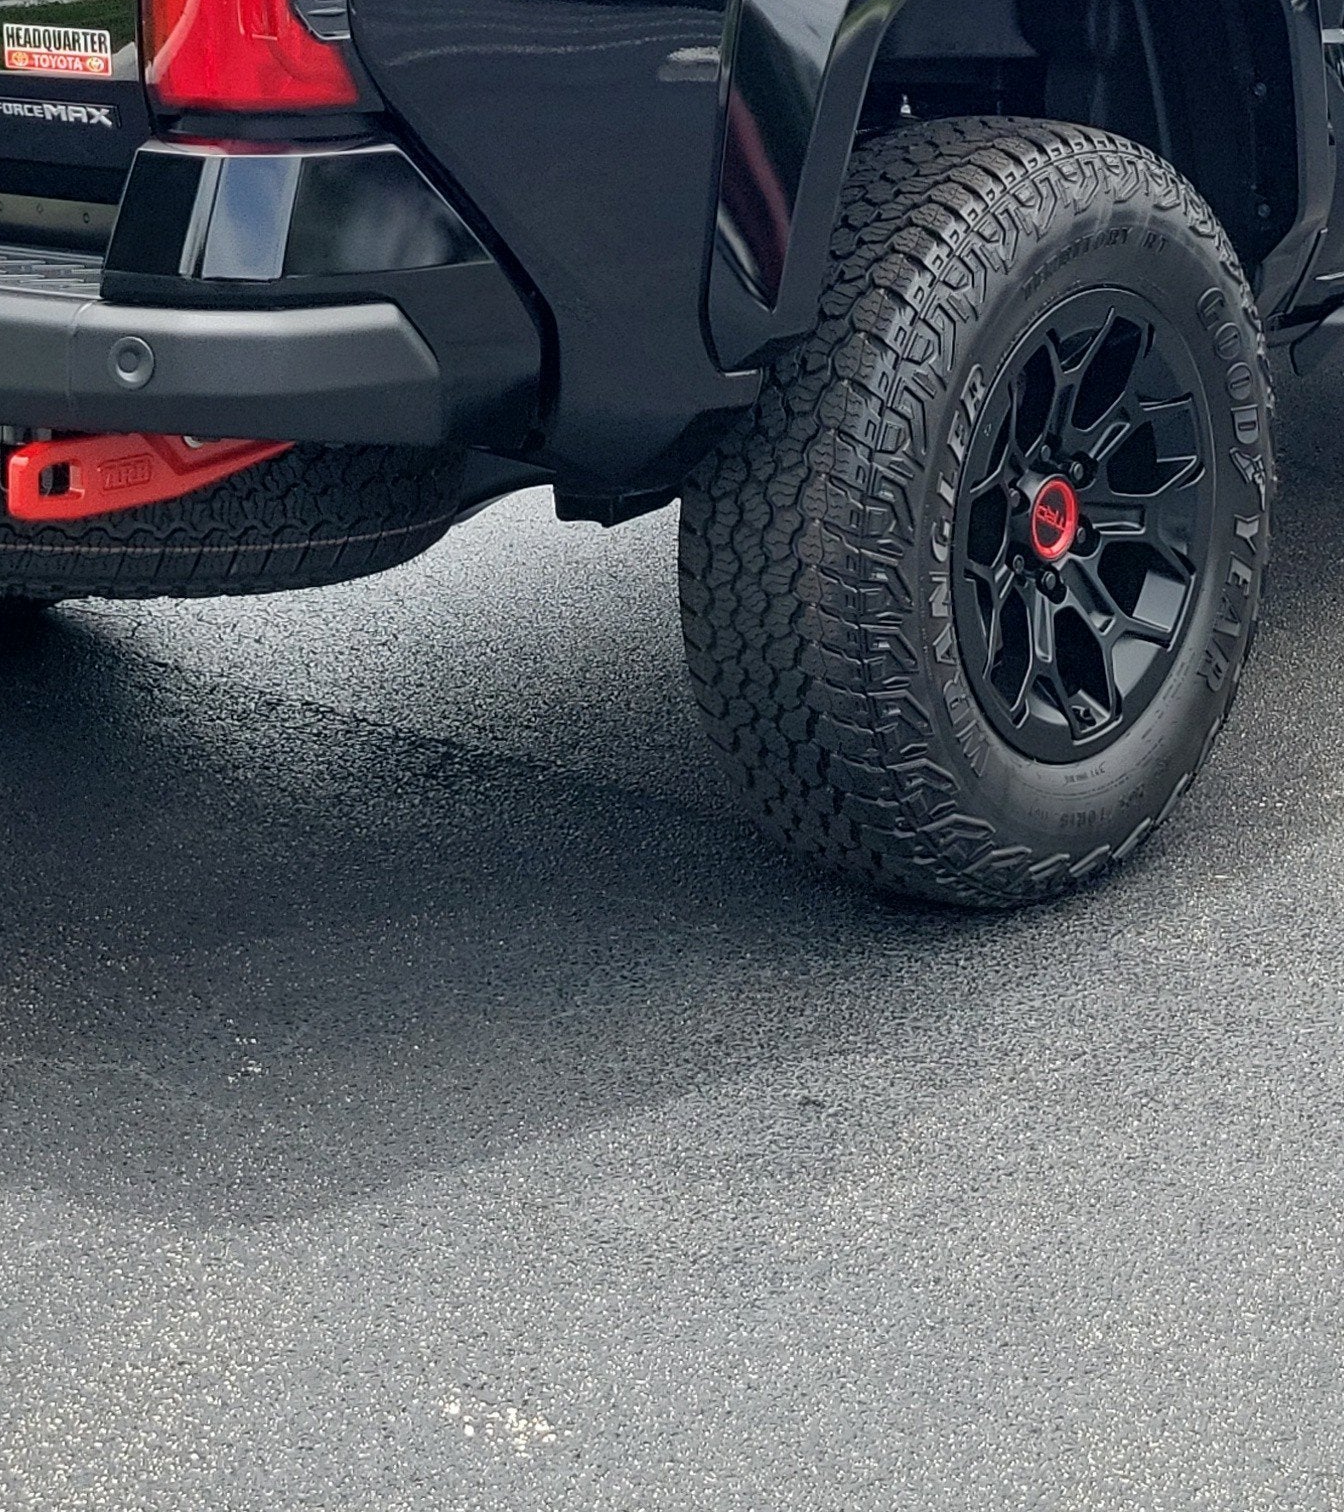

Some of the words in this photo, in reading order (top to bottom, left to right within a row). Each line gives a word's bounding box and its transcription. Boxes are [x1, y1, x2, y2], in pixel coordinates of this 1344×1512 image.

[5, 25, 108, 54] HEADQUARTER
[32, 54, 84, 71] TOYOTA
[929, 363, 990, 779] WRANGLER
